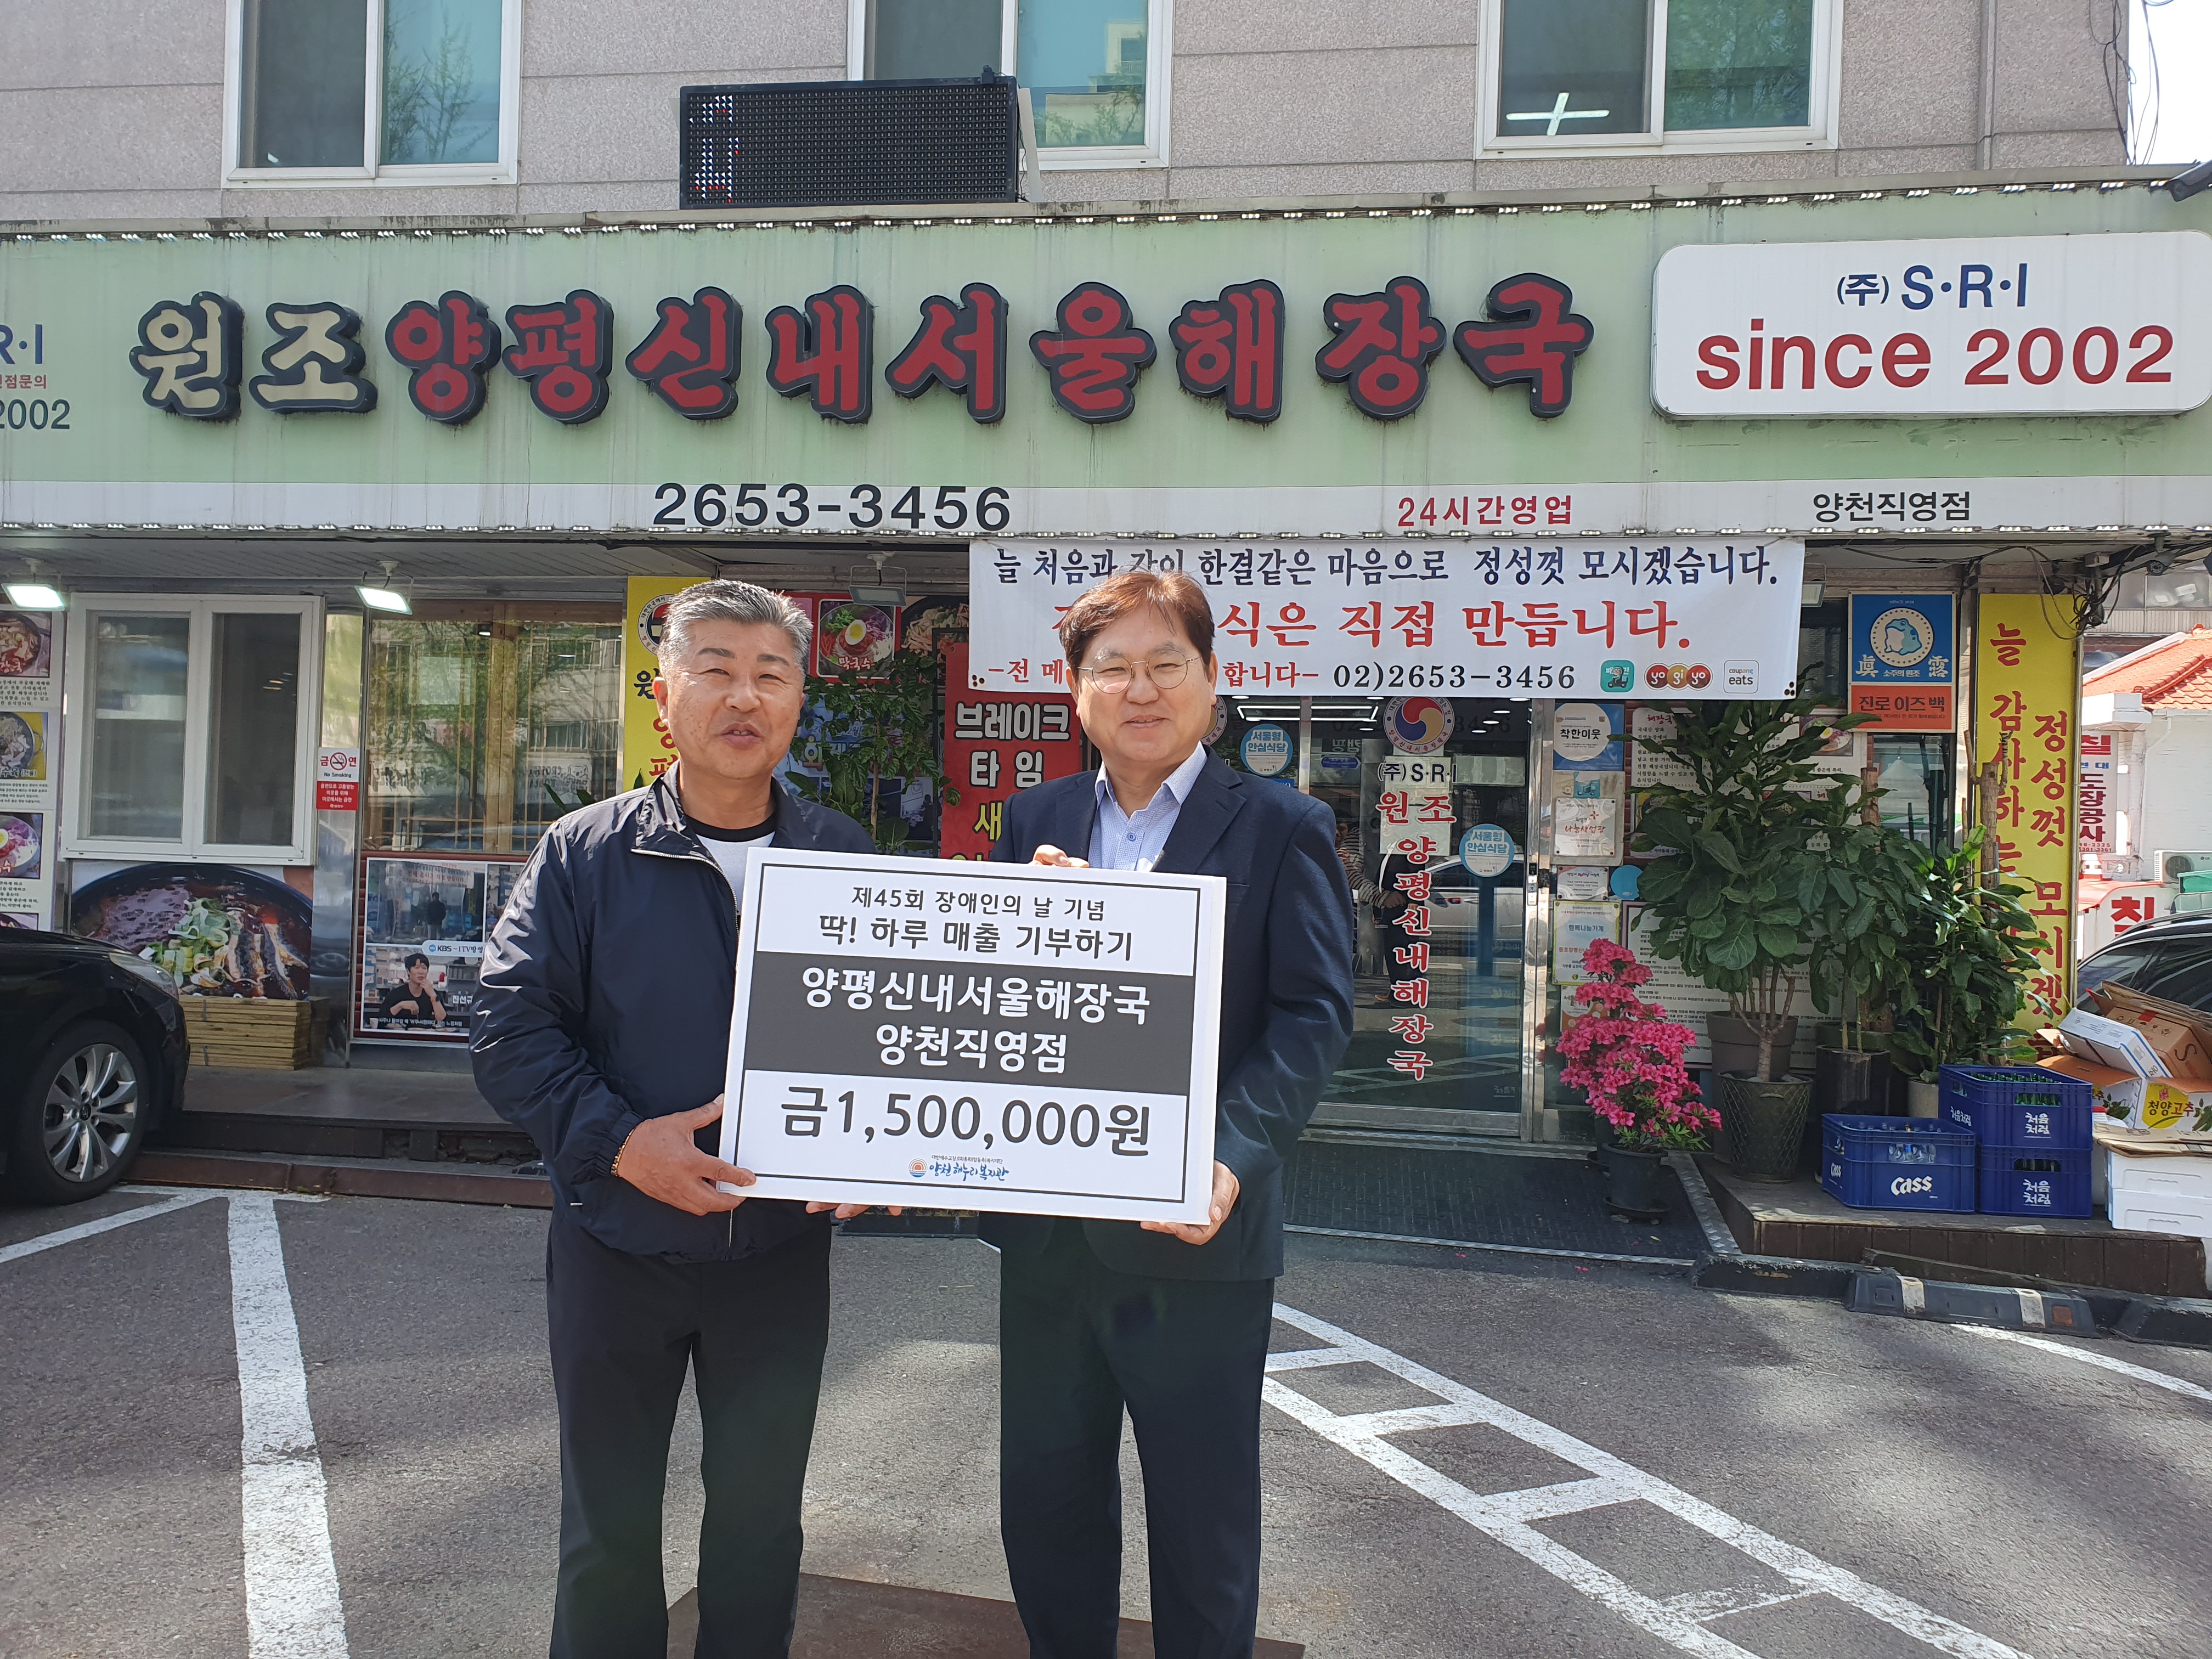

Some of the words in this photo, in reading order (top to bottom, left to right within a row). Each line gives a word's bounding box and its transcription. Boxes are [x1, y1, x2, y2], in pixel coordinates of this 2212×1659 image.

[1837, 273, 1889, 306] (주)
[1696, 318, 1932, 390] since
[1964, 325, 2174, 386] 2002
[654, 483, 1011, 531] 2653-3456
[1398, 496, 1572, 528] 24시간영업
[1813, 491, 1971, 522] 양천직영점
[994, 548, 1022, 584] 늘
[1033, 548, 1119, 585] 처음과
[1198, 549, 1317, 586] 한결같은
[1327, 549, 1449, 586] 마음으로
[1473, 546, 1564, 585] 정성껏
[1578, 545, 1778, 585] 모시겠습니다.
[1217, 601, 1318, 648] 식은
[1338, 600, 1436, 648] 직접
[1462, 600, 1690, 649] 만듭니다.
[1989, 622, 2027, 667] 늘
[838, 656, 871, 671] 막국수
[1333, 663, 1575, 692] 02)2653-3456
[1729, 675, 1753, 685] eats
[1859, 696, 1891, 712] 진로
[1928, 696, 1945, 712] 백
[954, 702, 1070, 741] 브레이크
[1252, 731, 1282, 741] 서울형
[1560, 729, 1601, 740] 착한이웃
[1247, 742, 1286, 753] 안심식당
[1378, 763, 1407, 782] (주)
[2030, 710, 2068, 848] 정성껏
[1467, 842, 1508, 854] 안심식당
[1472, 831, 1503, 842] 서울형
[851, 885, 925, 912] 제45회
[934, 889, 1022, 917] 장애인의
[1033, 896, 1054, 918] 날
[1064, 897, 1105, 922] 기념
[819, 915, 857, 946] 딱!
[871, 918, 929, 950] 하루
[943, 922, 1001, 953] 매출
[1015, 926, 1133, 961] 기부하기
[802, 966, 1151, 1025] 양평신내서울해장국
[876, 1023, 1068, 1074] 양천직영점
[781, 1085, 1150, 1157] 금1,500,000원
[2024, 1111, 2050, 1124] 처음
[2148, 1100, 2194, 1118] 청양고추
[2024, 1124, 2050, 1135] 처럼
[2022, 1178, 2051, 1192] 처음
[2023, 1192, 2052, 1205] 처럼
